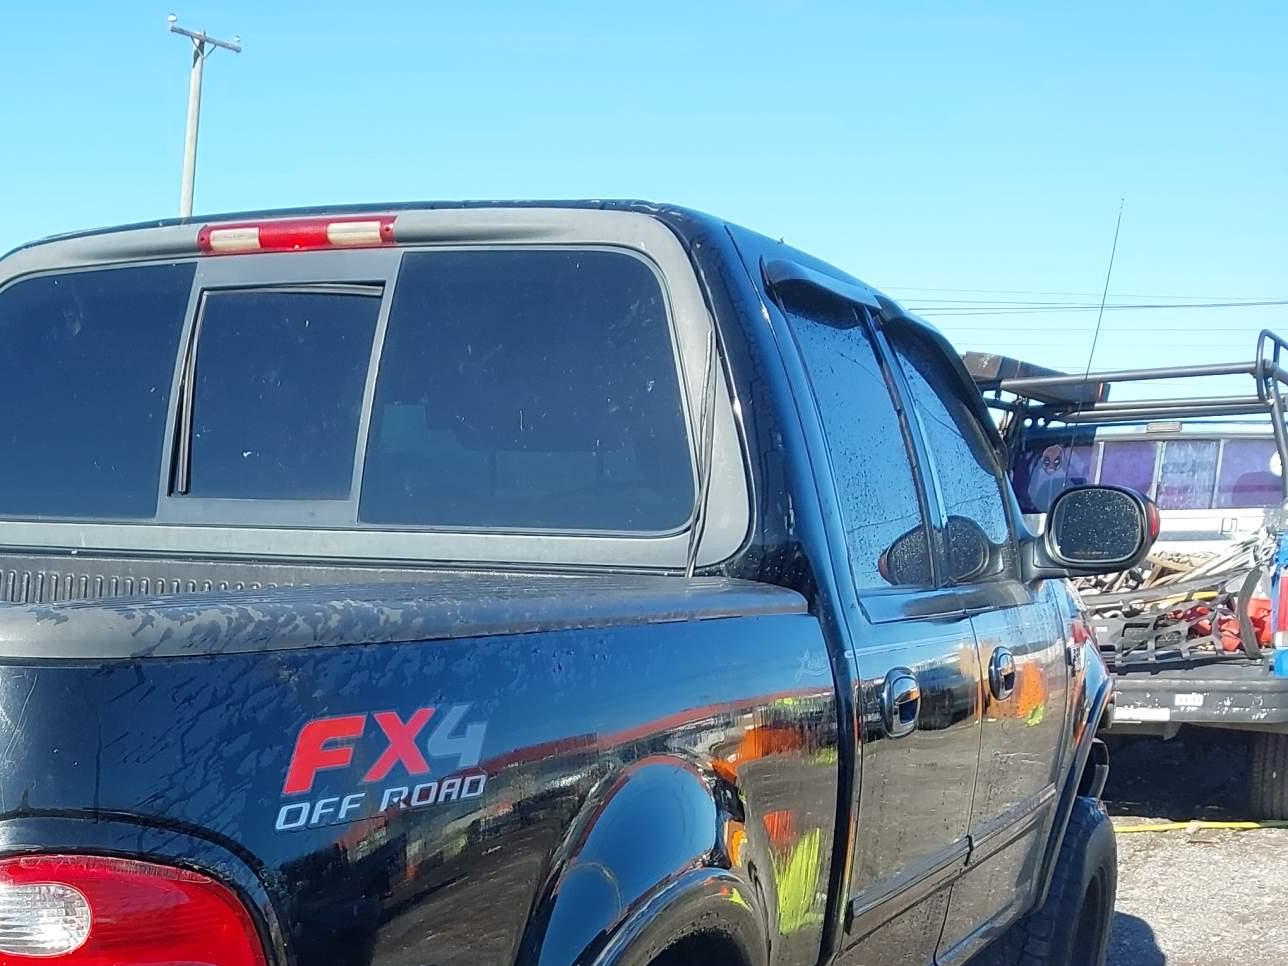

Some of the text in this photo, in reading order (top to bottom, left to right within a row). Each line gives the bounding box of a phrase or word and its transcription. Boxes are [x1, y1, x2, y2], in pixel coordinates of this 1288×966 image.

[283, 704, 488, 795] FX4
[275, 774, 487, 830] OFF ROAD
